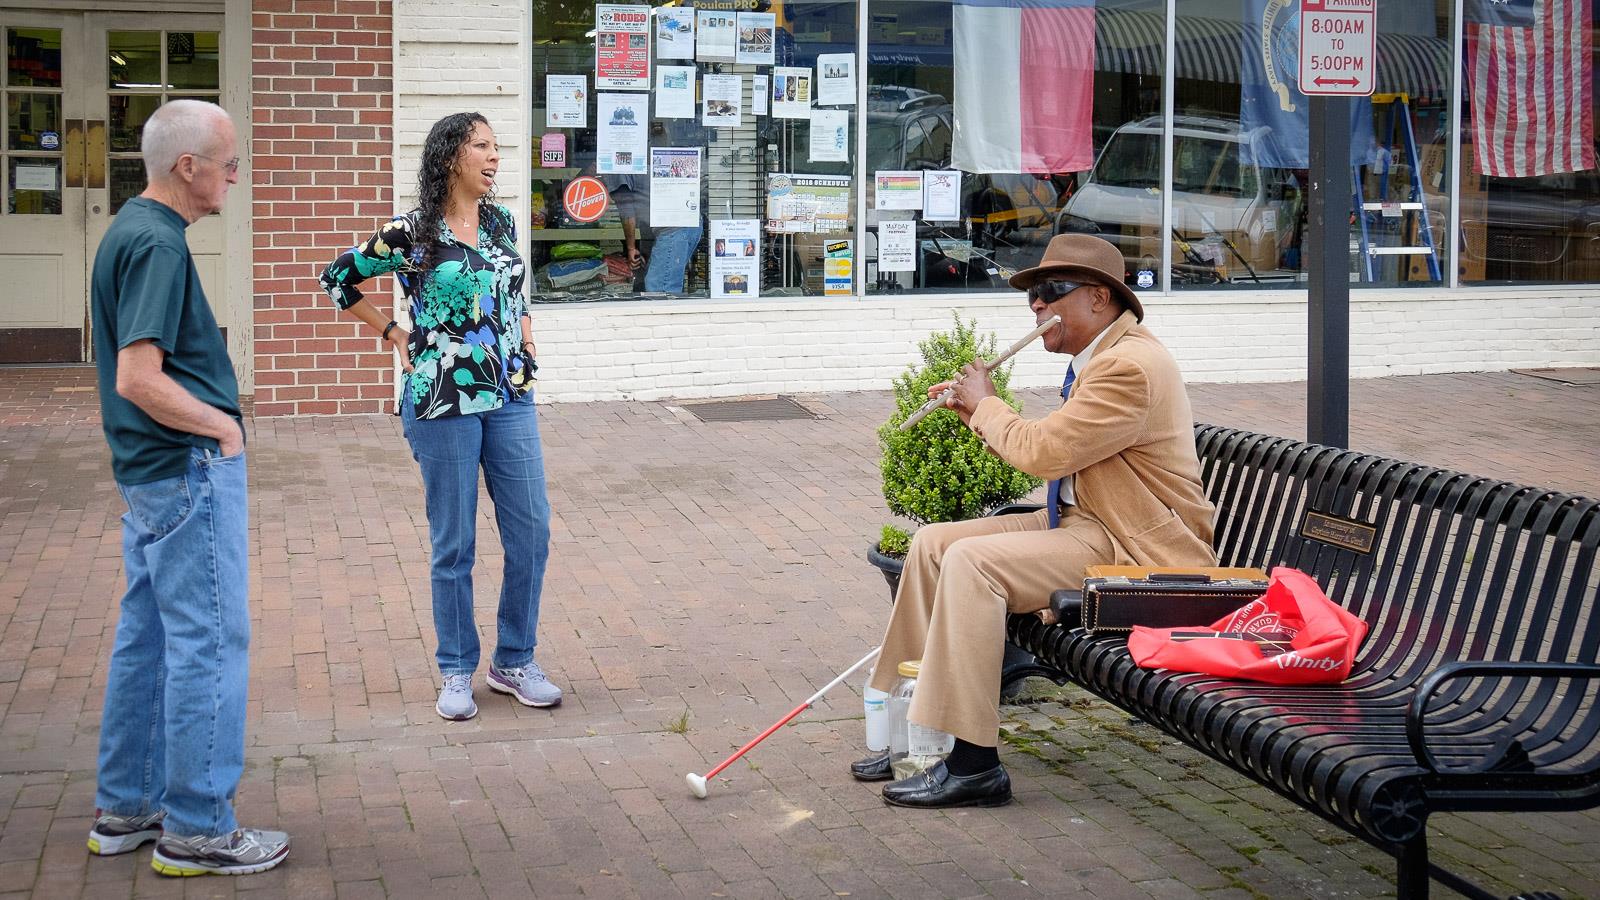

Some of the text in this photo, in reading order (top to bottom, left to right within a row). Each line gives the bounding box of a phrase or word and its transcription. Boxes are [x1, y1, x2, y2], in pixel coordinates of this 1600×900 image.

[734, 0, 759, 9] PRO
[613, 13, 646, 22] RODEO
[1312, 19, 1364, 34] 8:00AM
[1331, 38, 1344, 50] TO
[1311, 55, 1364, 71] 5:00PM
[1232, 619, 1244, 633] PRO
[1249, 617, 1272, 632] GUAR
